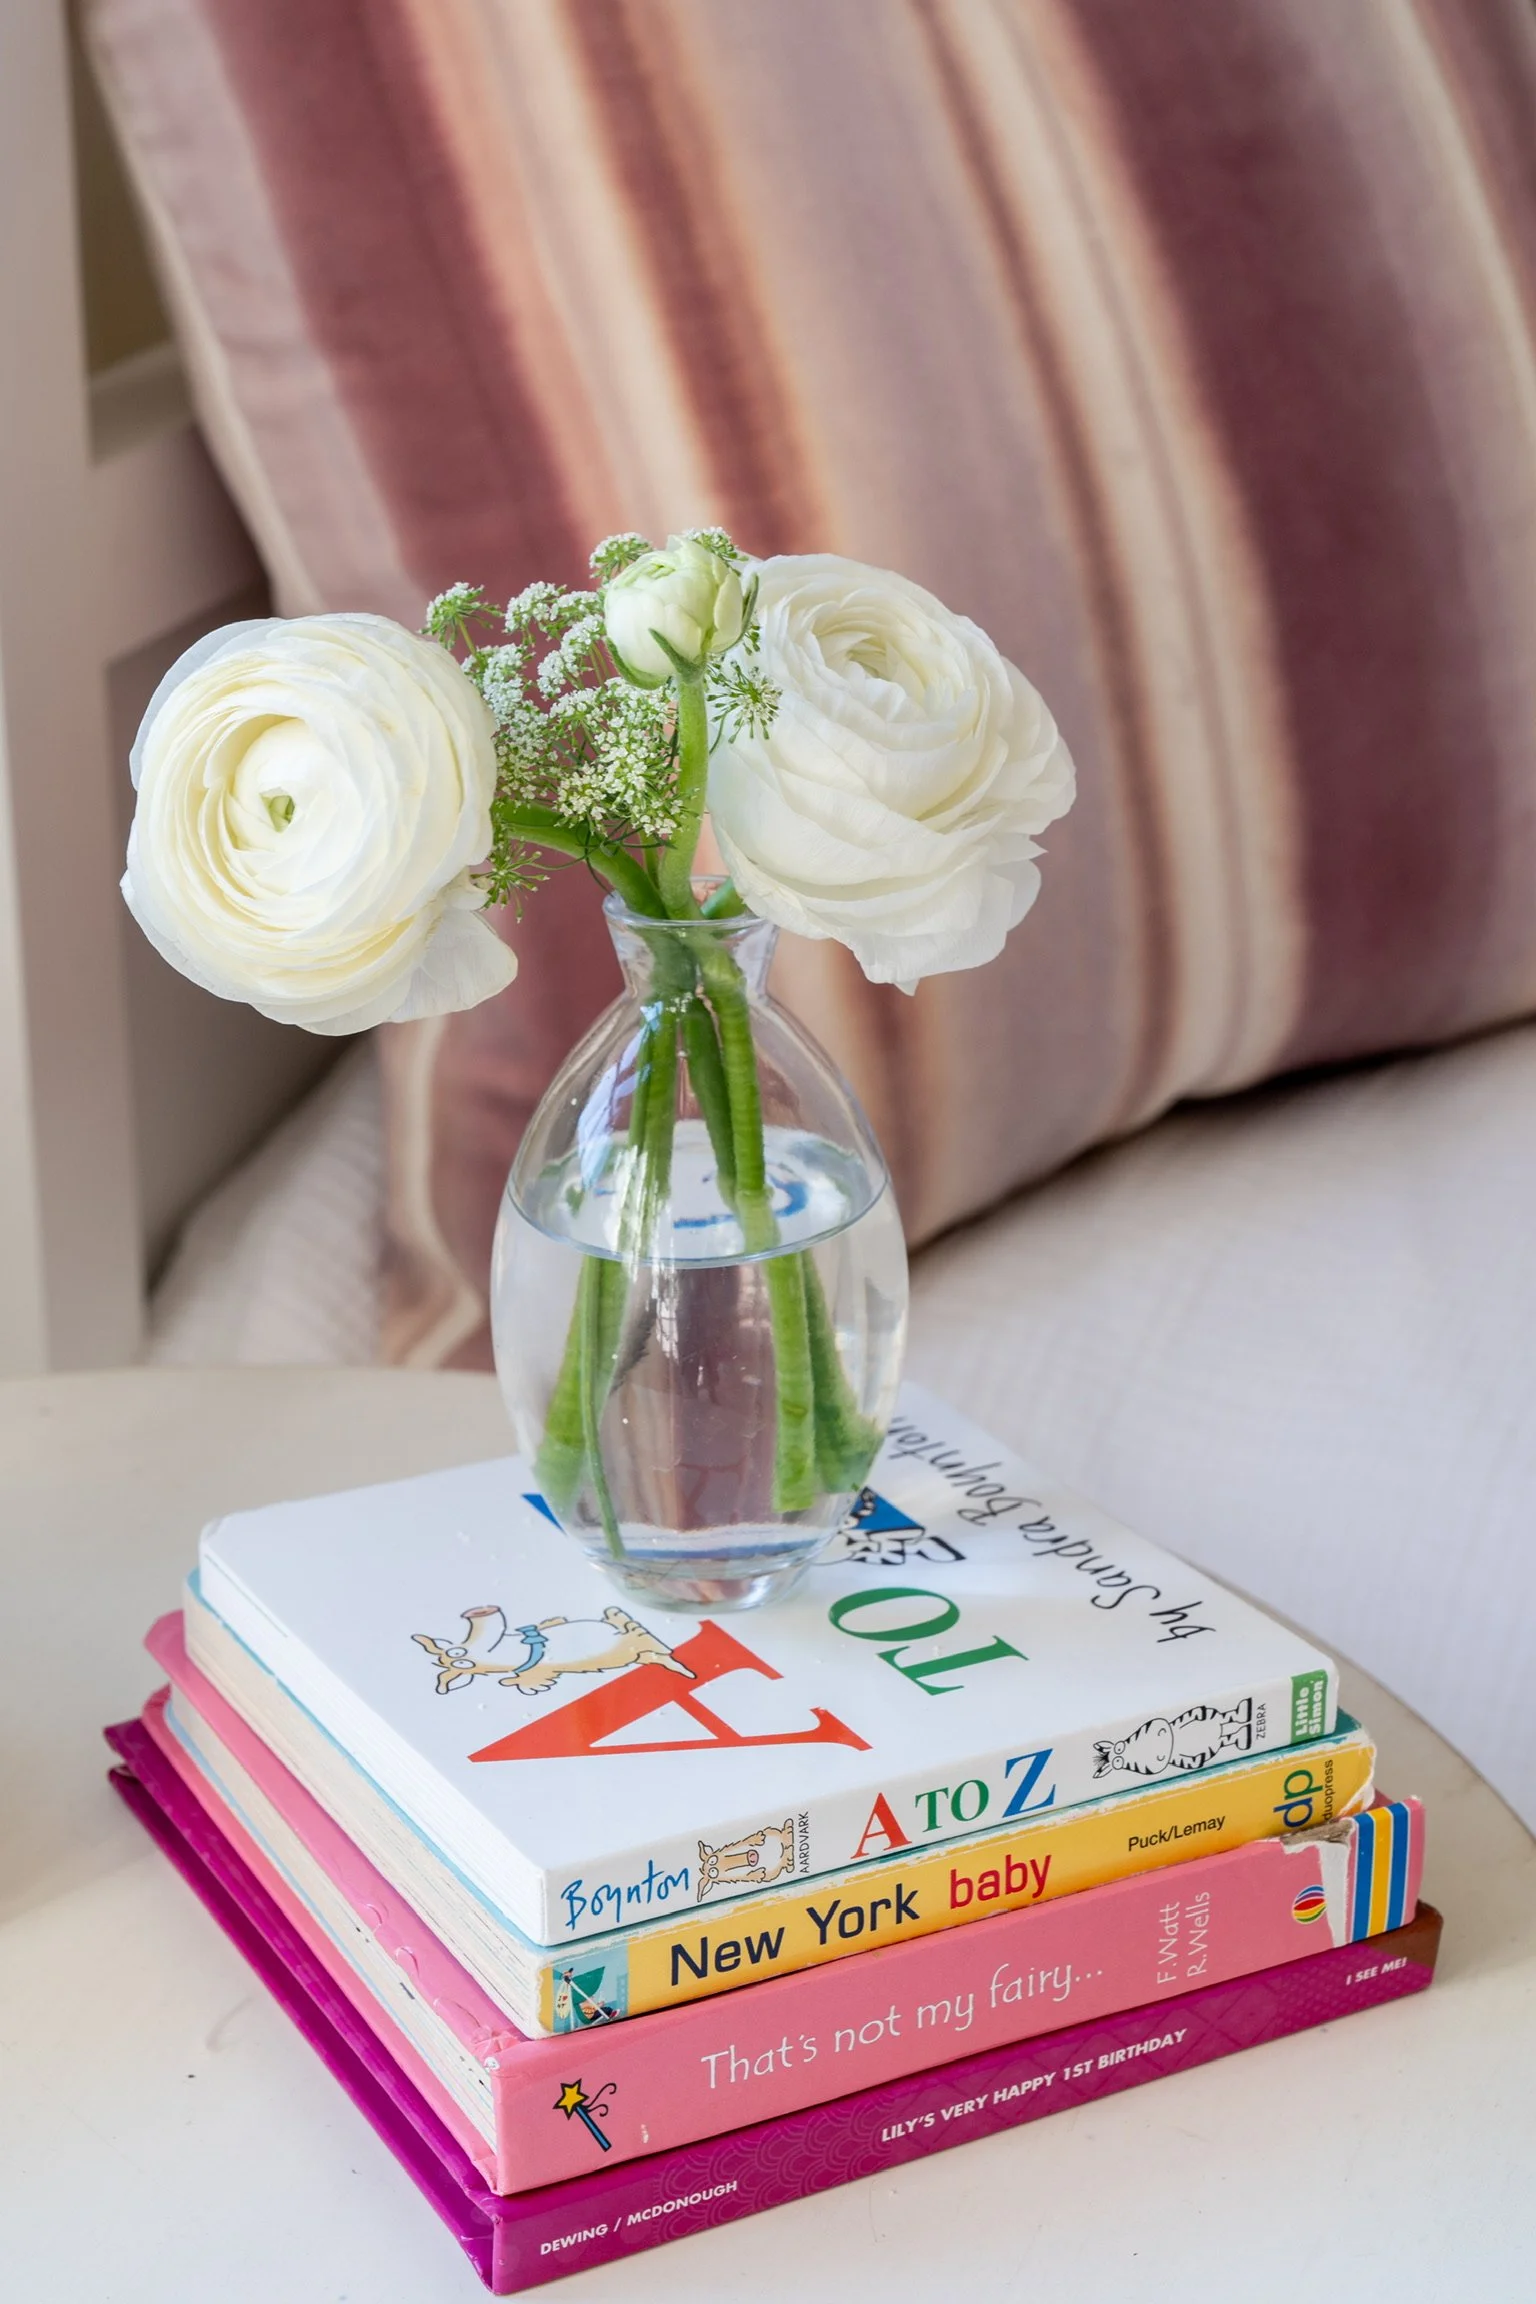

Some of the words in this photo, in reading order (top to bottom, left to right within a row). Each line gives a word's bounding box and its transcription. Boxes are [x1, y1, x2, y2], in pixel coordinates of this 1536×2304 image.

[1017, 1515, 1161, 1610] Sandra
[1149, 1600, 1217, 1643] by
[467, 1618, 875, 1763] A
[828, 1586, 1031, 1697] TO
[1308, 1679, 1325, 1736] Simon
[1255, 1702, 1267, 1740] ZEBRA
[1295, 1685, 1311, 1738] Little
[850, 1791, 913, 1860] A
[914, 1779, 990, 1833] TO
[1001, 1747, 1057, 1819] Z
[1320, 1758, 1335, 1825] duopress
[798, 1811, 810, 1874] AARDVARK
[1127, 1815, 1227, 1852] Puck/Lemay
[560, 1859, 690, 1931] Boynton
[670, 1926, 786, 1987] New
[805, 1882, 921, 1946] York
[949, 1853, 1053, 1910] baby
[1344, 1974, 1353, 1987] I
[1354, 1965, 1379, 1984] SEE
[1380, 1956, 1409, 1975] ME!
[700, 2034, 819, 2090] That's
[833, 2004, 903, 2054] not
[915, 1991, 976, 2033] my
[881, 2112, 936, 2143] LILY'S
[940, 2094, 989, 2121] VERY
[992, 2071, 1057, 2105] HAPPY
[1063, 2058, 1095, 2082] 1ST
[1097, 2028, 1188, 2070] BIRTHDAY
[540, 2223, 609, 2256] DEWING
[626, 2180, 739, 2226] MCDONOUGH
